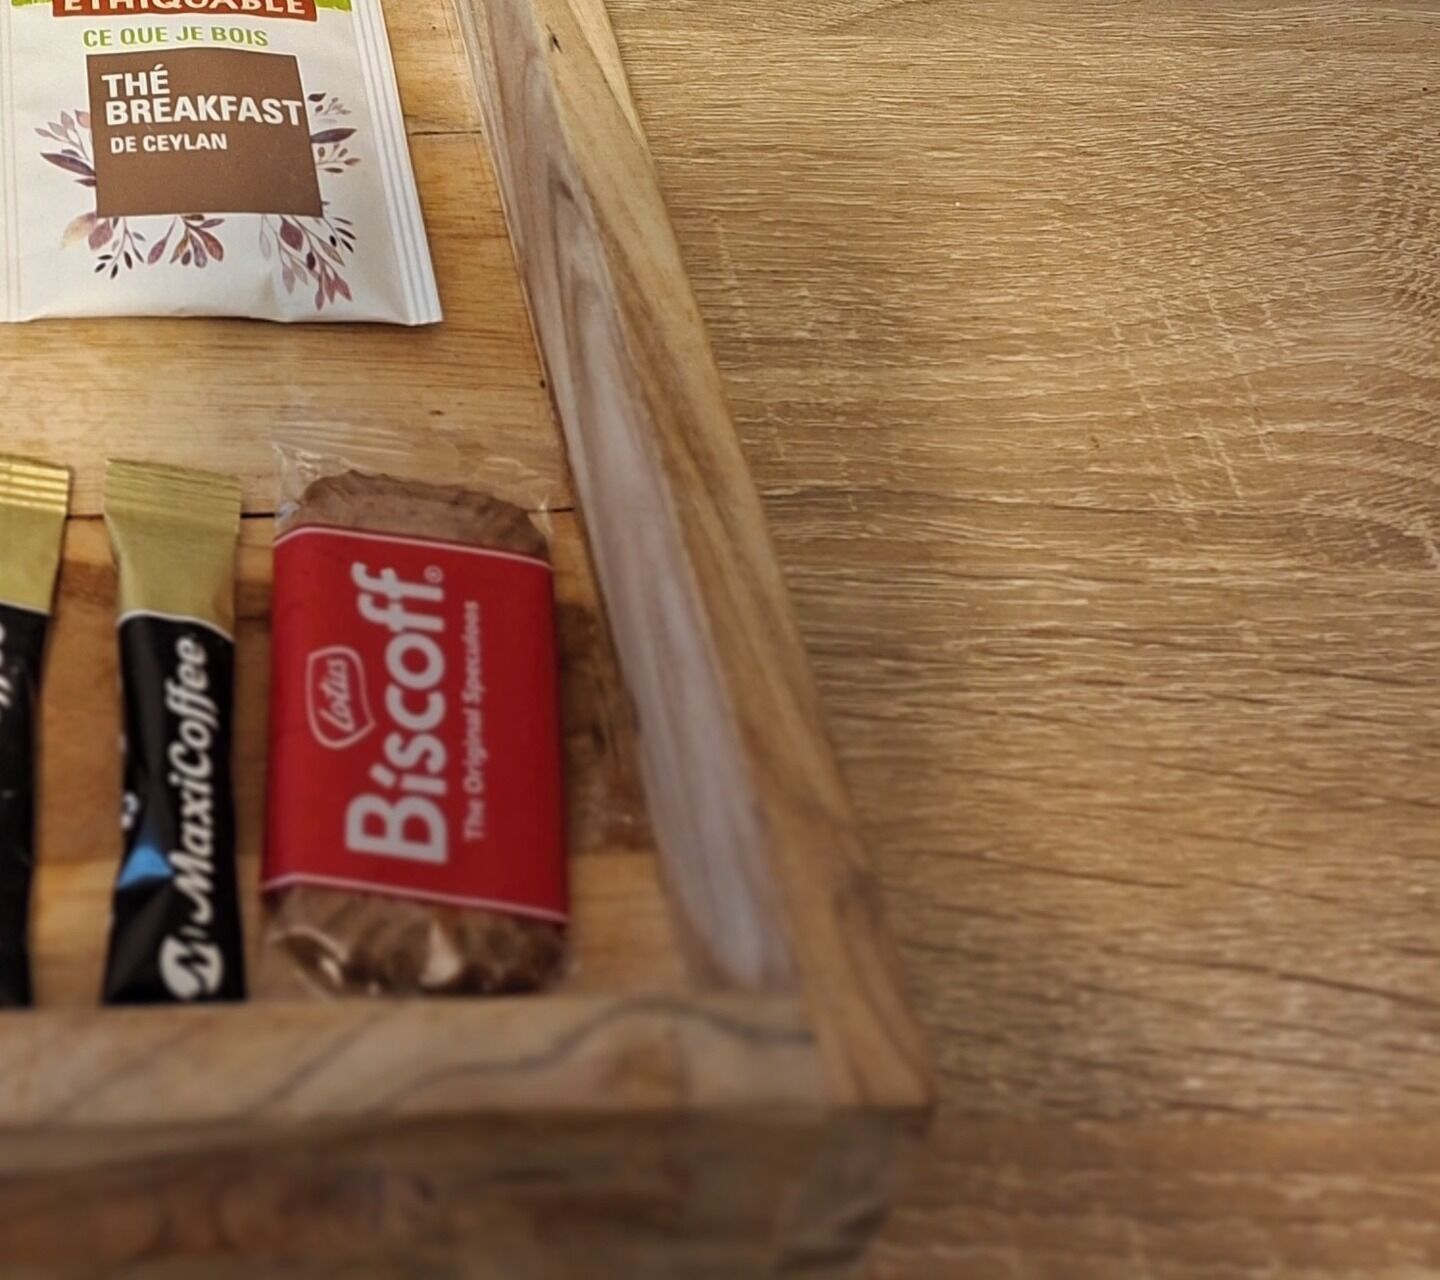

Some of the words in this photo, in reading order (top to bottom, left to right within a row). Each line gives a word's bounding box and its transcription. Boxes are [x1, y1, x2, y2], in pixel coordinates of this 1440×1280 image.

[83, 29, 112, 47] CE
[120, 26, 168, 45] QUE
[176, 26, 204, 41] JE
[211, 27, 268, 47] BOIS
[101, 64, 169, 97] THÉ
[105, 94, 302, 126] BREAKFAST
[111, 135, 137, 154] DE
[143, 133, 227, 153] CEYLAN
[166, 637, 219, 924] MaxiCoffee
